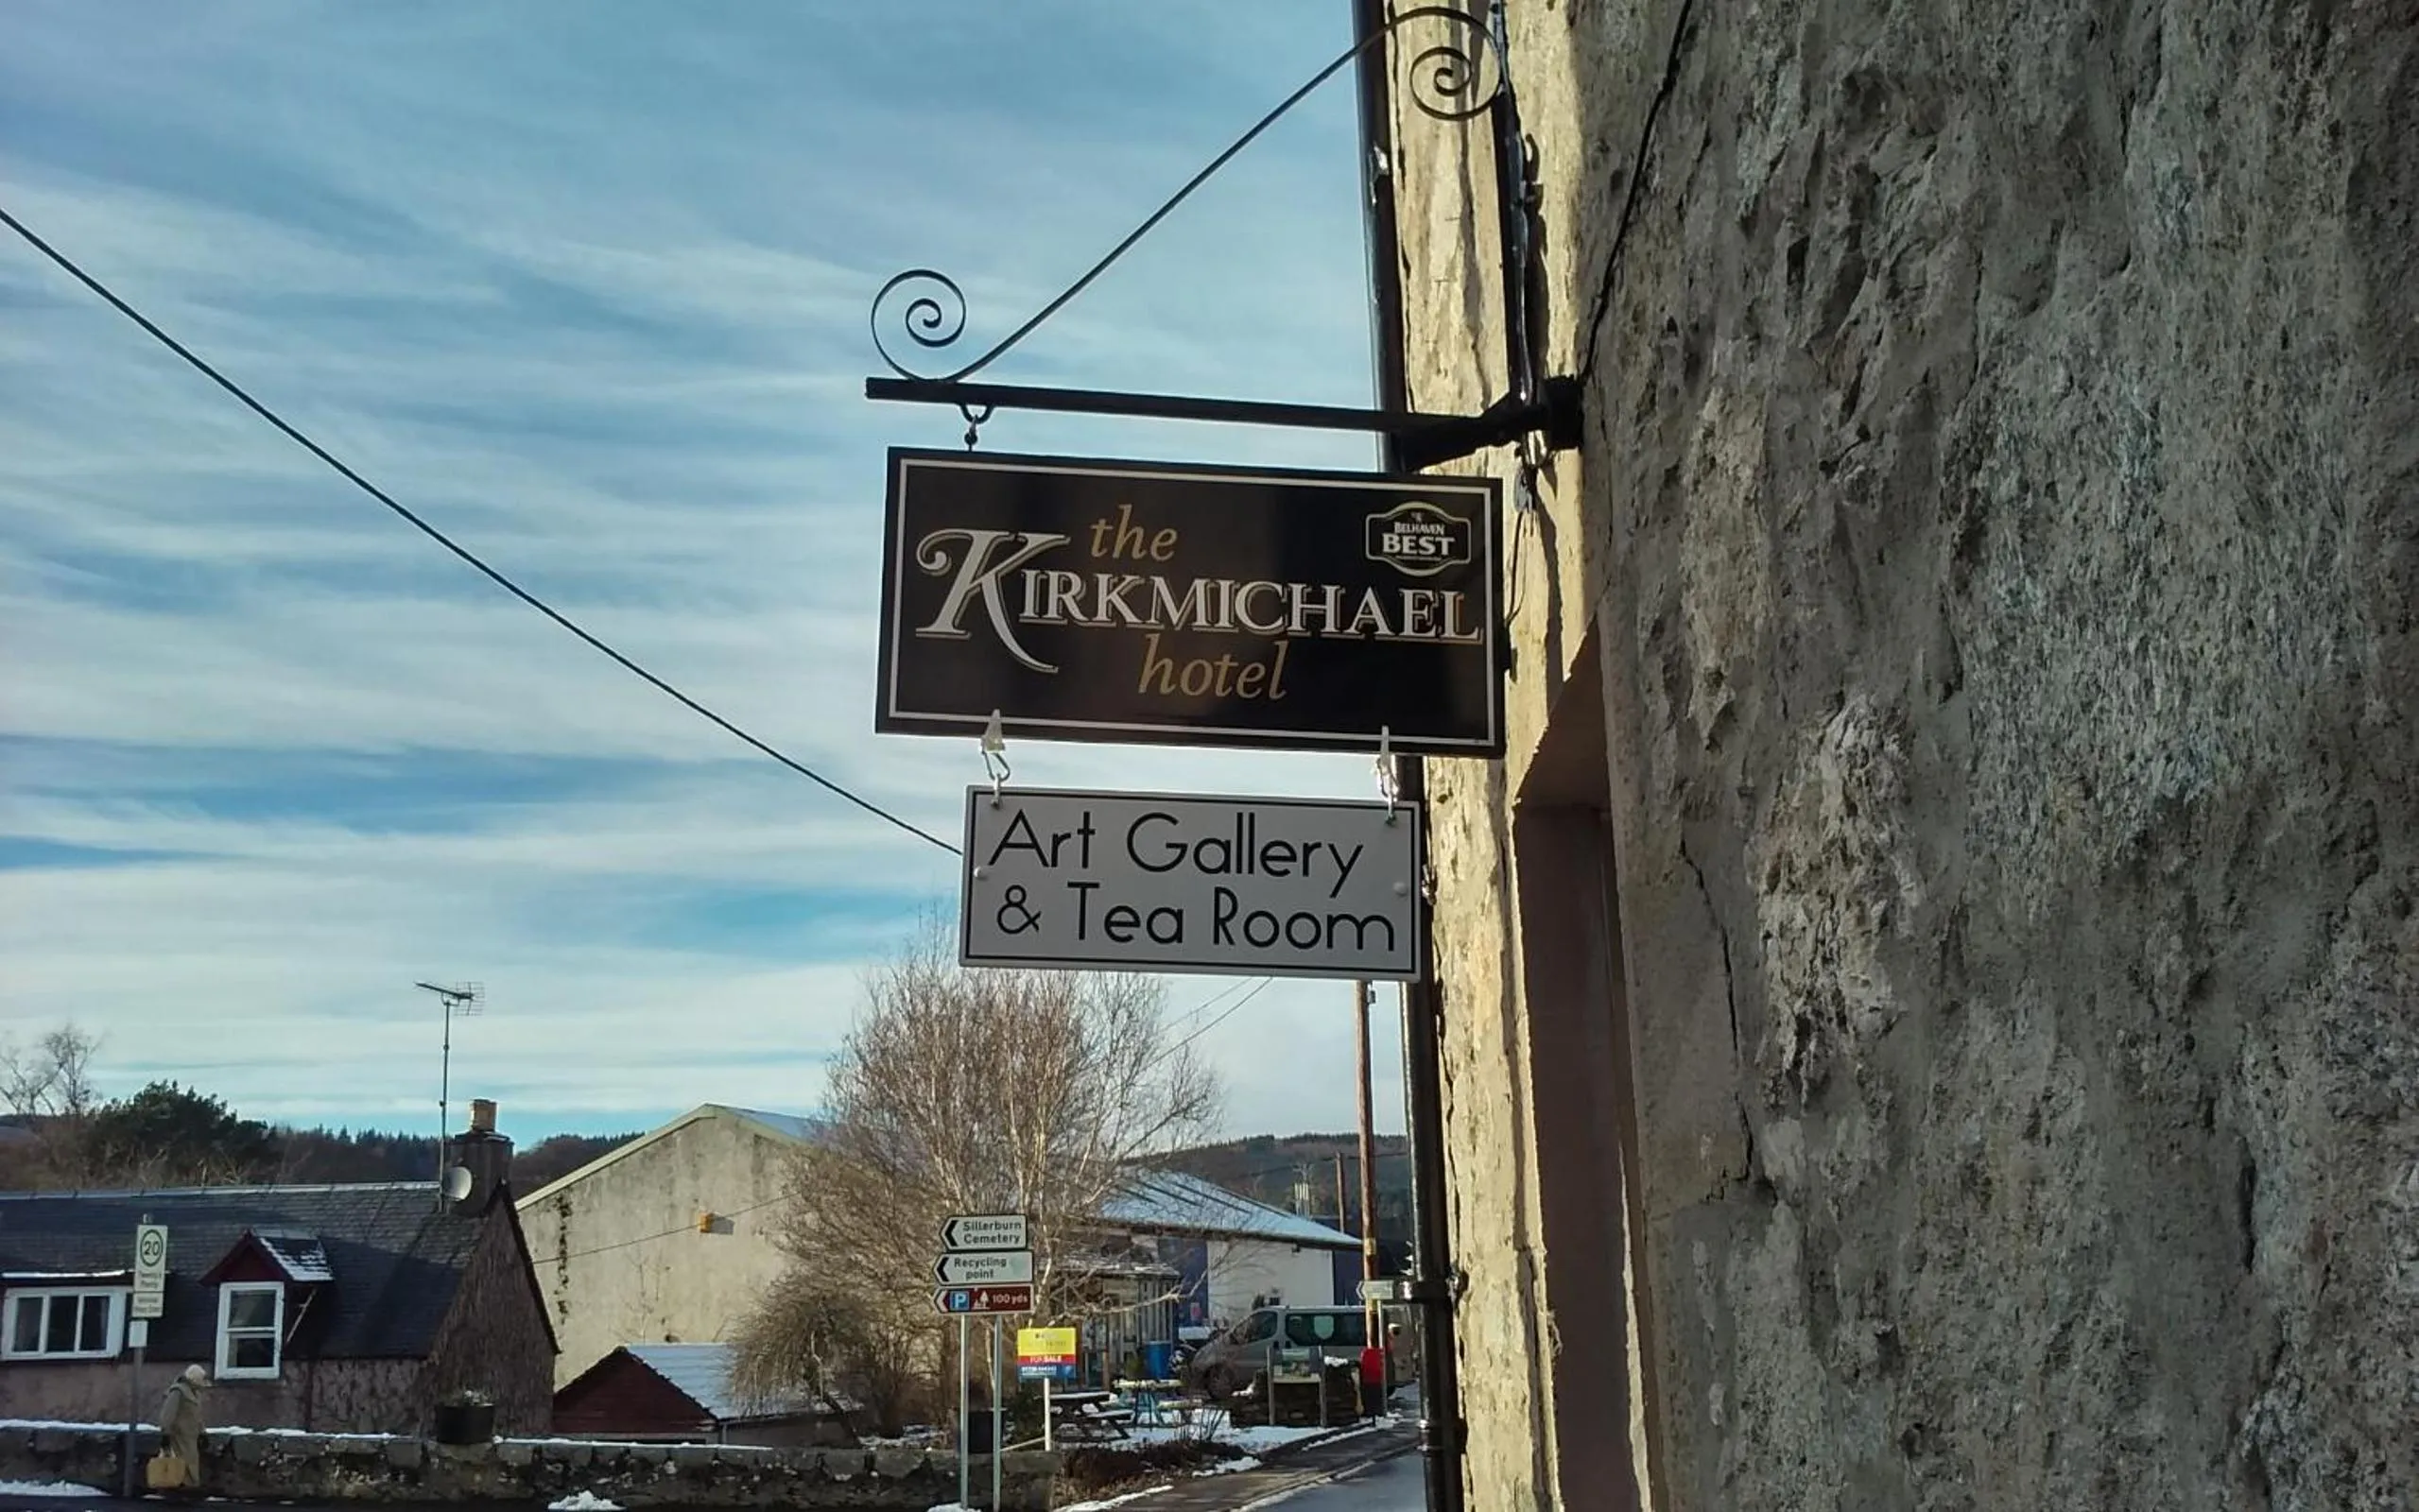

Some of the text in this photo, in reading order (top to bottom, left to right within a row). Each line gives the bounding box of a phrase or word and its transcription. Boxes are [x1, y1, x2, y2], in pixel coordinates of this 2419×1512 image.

[1091, 504, 1177, 561] the
[1382, 533, 1456, 556] BEST
[915, 527, 1484, 674] KIRKMICHAEL
[1137, 633, 1287, 701] hotel
[988, 808, 1364, 899] Art Gallery
[995, 881, 1395, 952] & Tea Room
[963, 1220, 1022, 1231] Sillerburn
[144, 1241, 160, 1255] 20
[963, 1233, 1021, 1245] Cemetery
[953, 1256, 1007, 1268] Recycling
[965, 1269, 994, 1280] point
[955, 1293, 1028, 1308] P 100 yds
